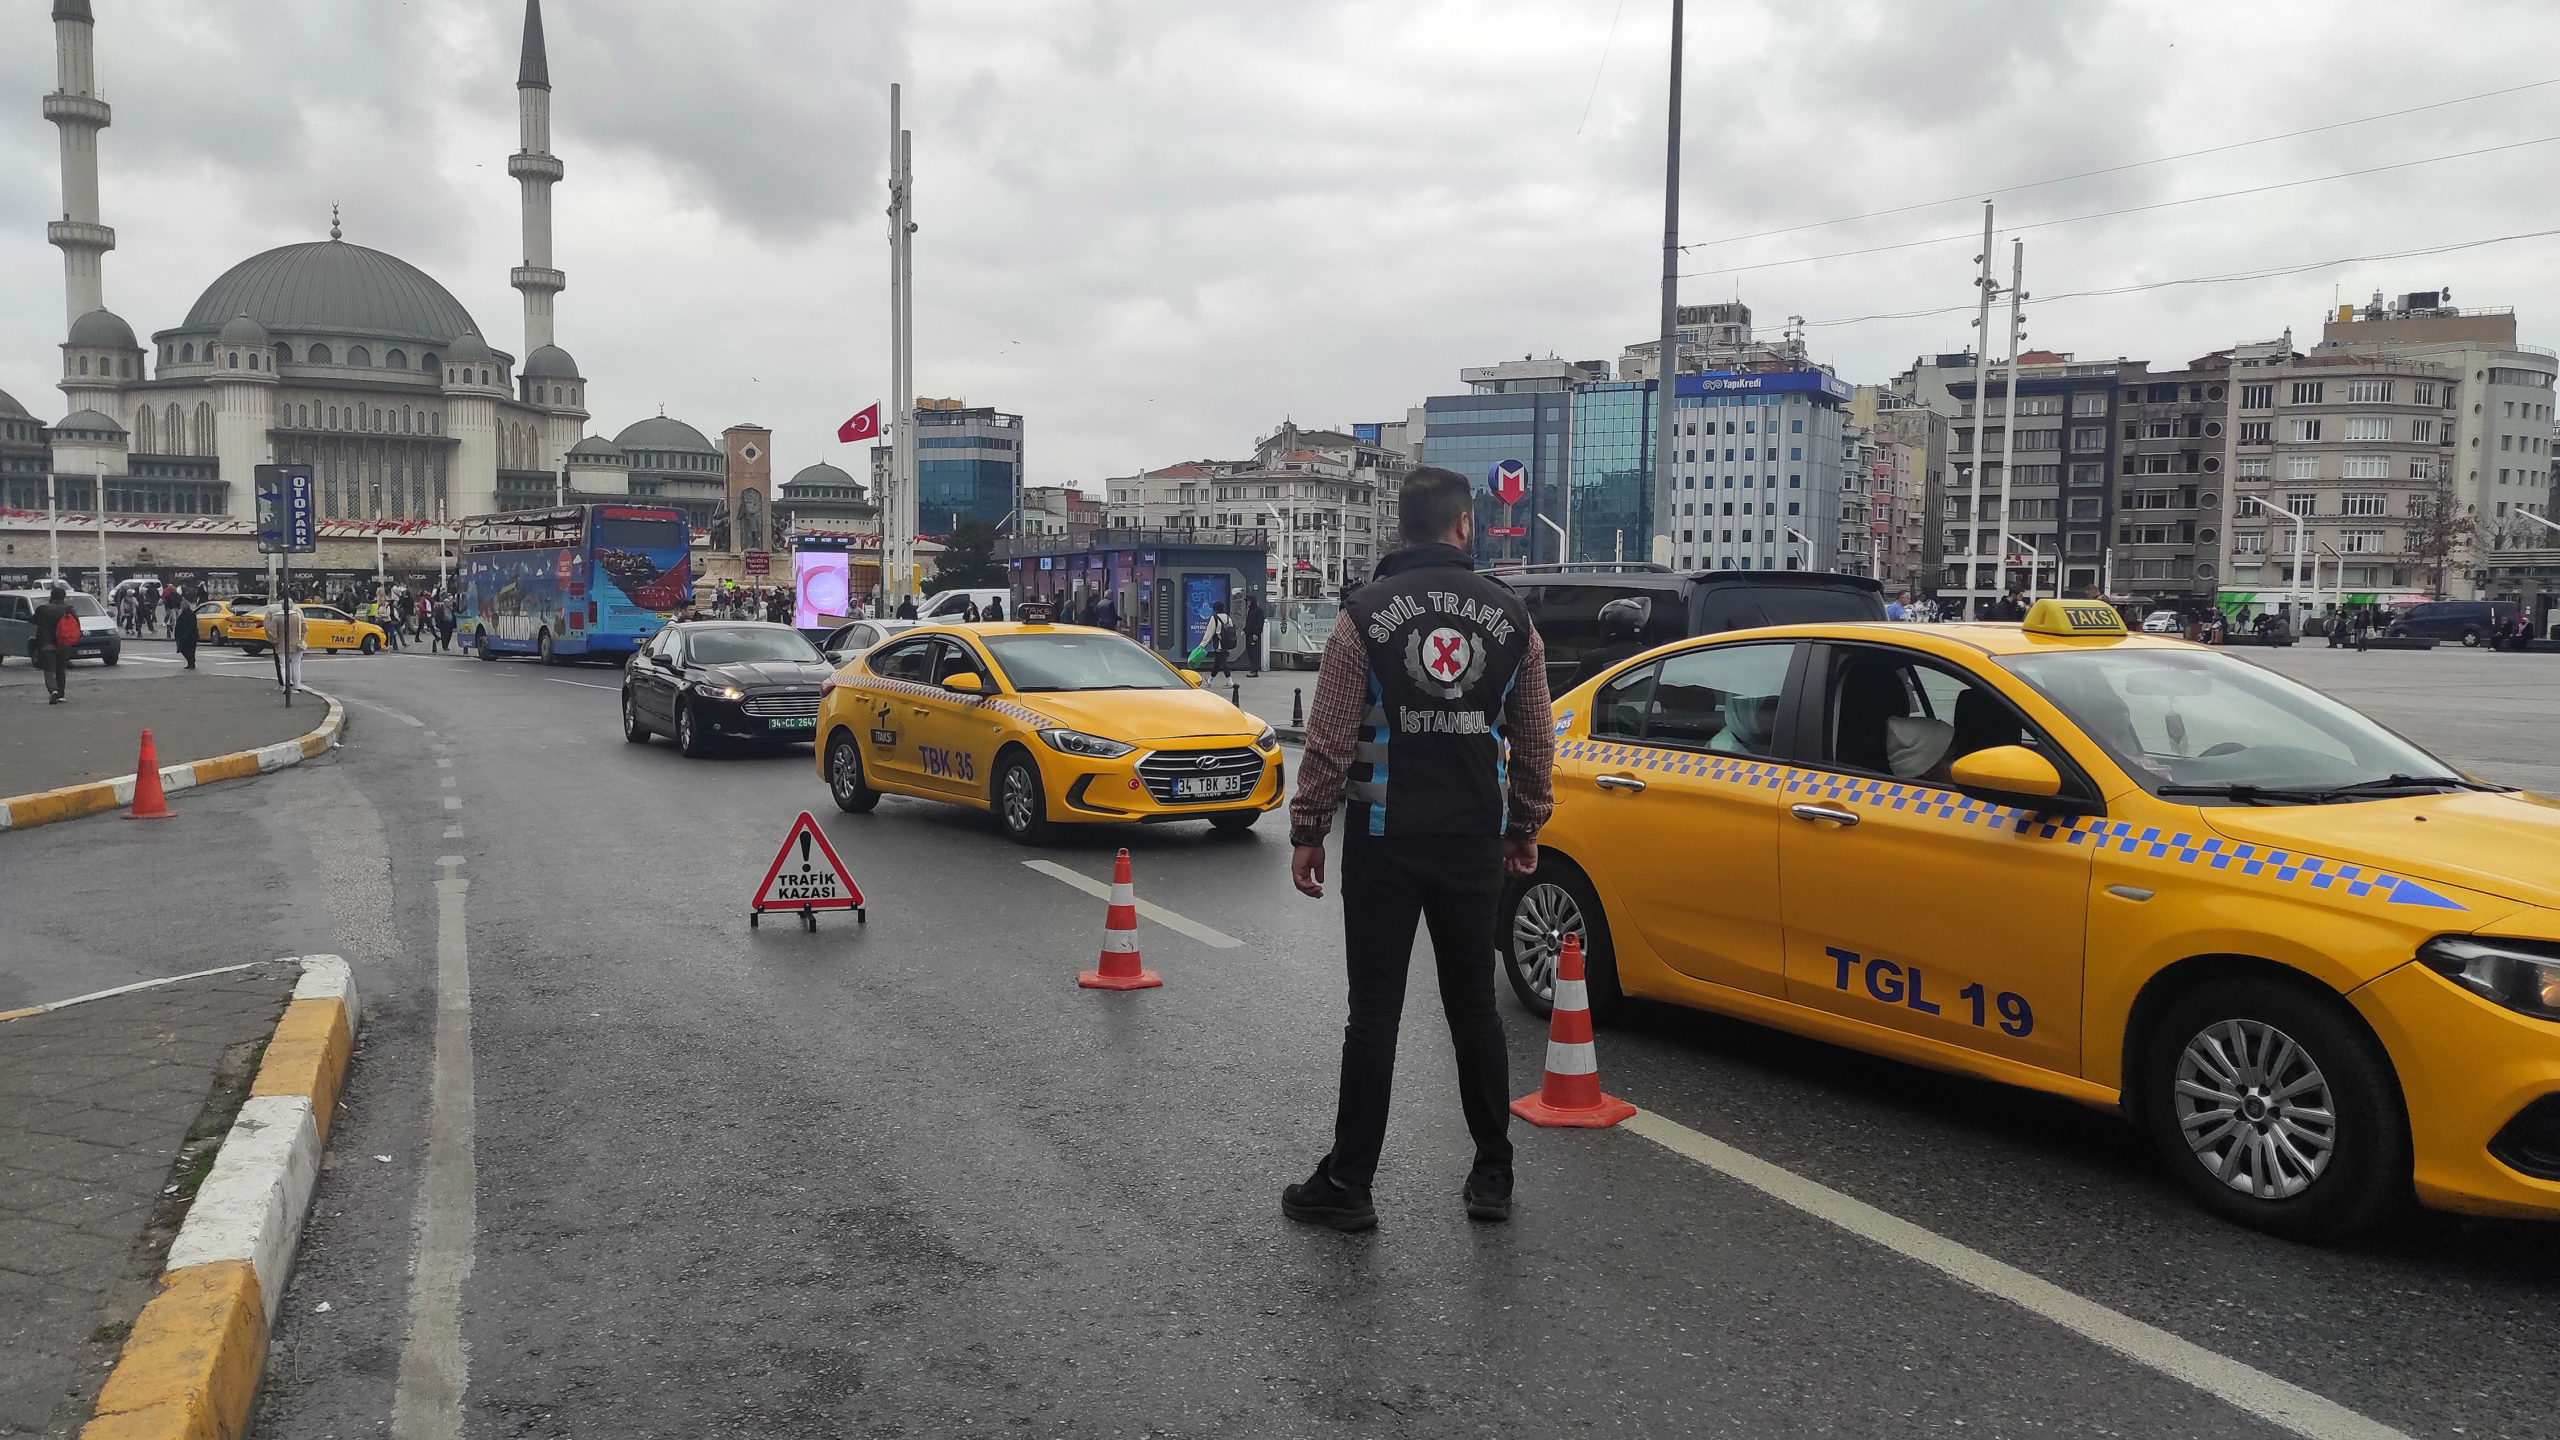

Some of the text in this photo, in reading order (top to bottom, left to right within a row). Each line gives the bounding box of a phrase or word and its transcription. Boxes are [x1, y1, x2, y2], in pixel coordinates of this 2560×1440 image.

[293, 477, 307, 545] OTOPARK
[1368, 591, 1516, 646] SİVİL TRAFİK
[771, 717, 817, 727] 34 CC 2647
[1400, 706, 1490, 734] İSTANBUL
[918, 745, 974, 781] TBK 35
[1179, 779, 1192, 793] 34
[1199, 777, 1219, 791] TBK
[1225, 776, 1238, 790] 35
[778, 871, 836, 886] TRAFİK
[779, 886, 836, 899] KAZASI
[1825, 945, 2034, 1038] TGL 19
